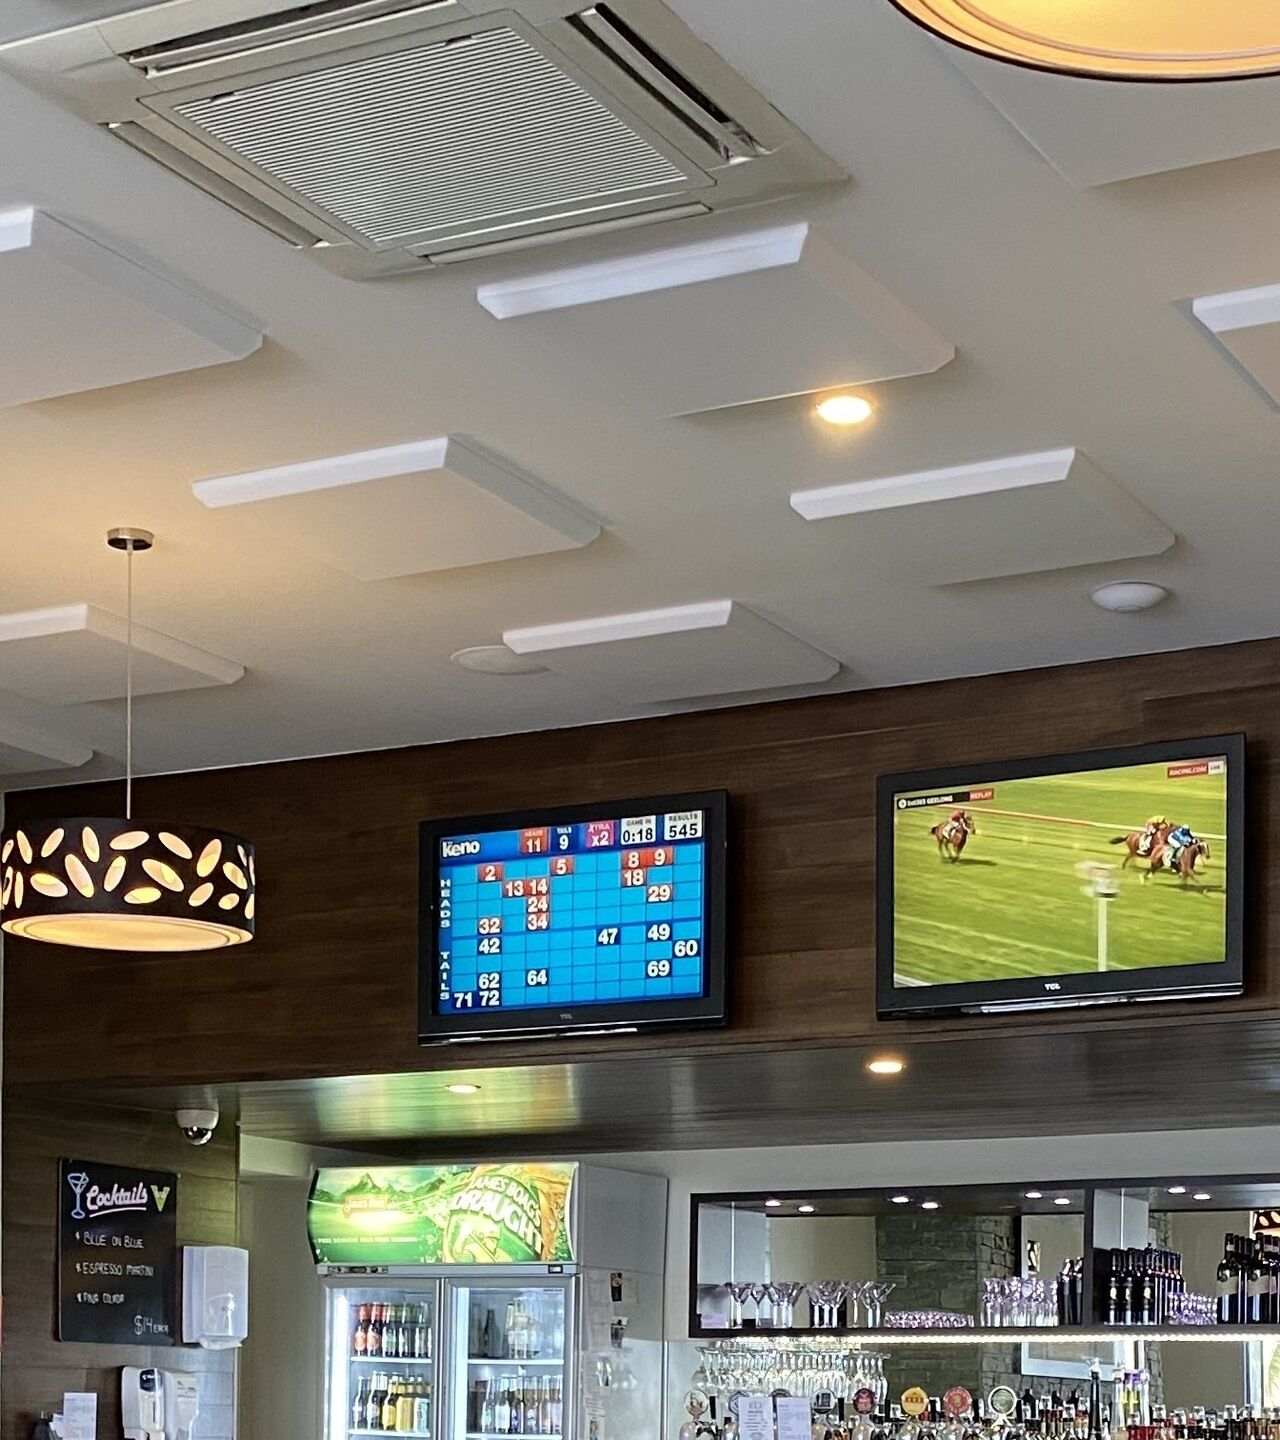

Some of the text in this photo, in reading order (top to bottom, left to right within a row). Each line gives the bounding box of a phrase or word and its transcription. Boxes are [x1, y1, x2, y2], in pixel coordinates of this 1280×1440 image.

[623, 828, 653, 843] 0:18
[669, 823, 698, 838] 545
[526, 838, 541, 853] 11
[559, 835, 569, 850] 9
[484, 849, 666, 881] 2 5 8 9
[506, 869, 644, 897] 13 14 18
[528, 885, 671, 913] 24 29
[479, 913, 548, 935] 32 34
[479, 923, 670, 954] 42 47 49
[674, 940, 698, 957] 60
[479, 960, 670, 989] 62 64 69
[1044, 983, 1061, 991] TCL
[454, 990, 500, 1008] 71 72
[86, 1182, 148, 1210] Cocktails
[451, 1189, 545, 1254] DRAUGHT
[83, 1231, 106, 1246] BLUE
[124, 1235, 144, 1249] BLUE
[83, 1262, 123, 1276] ESPRESSO
